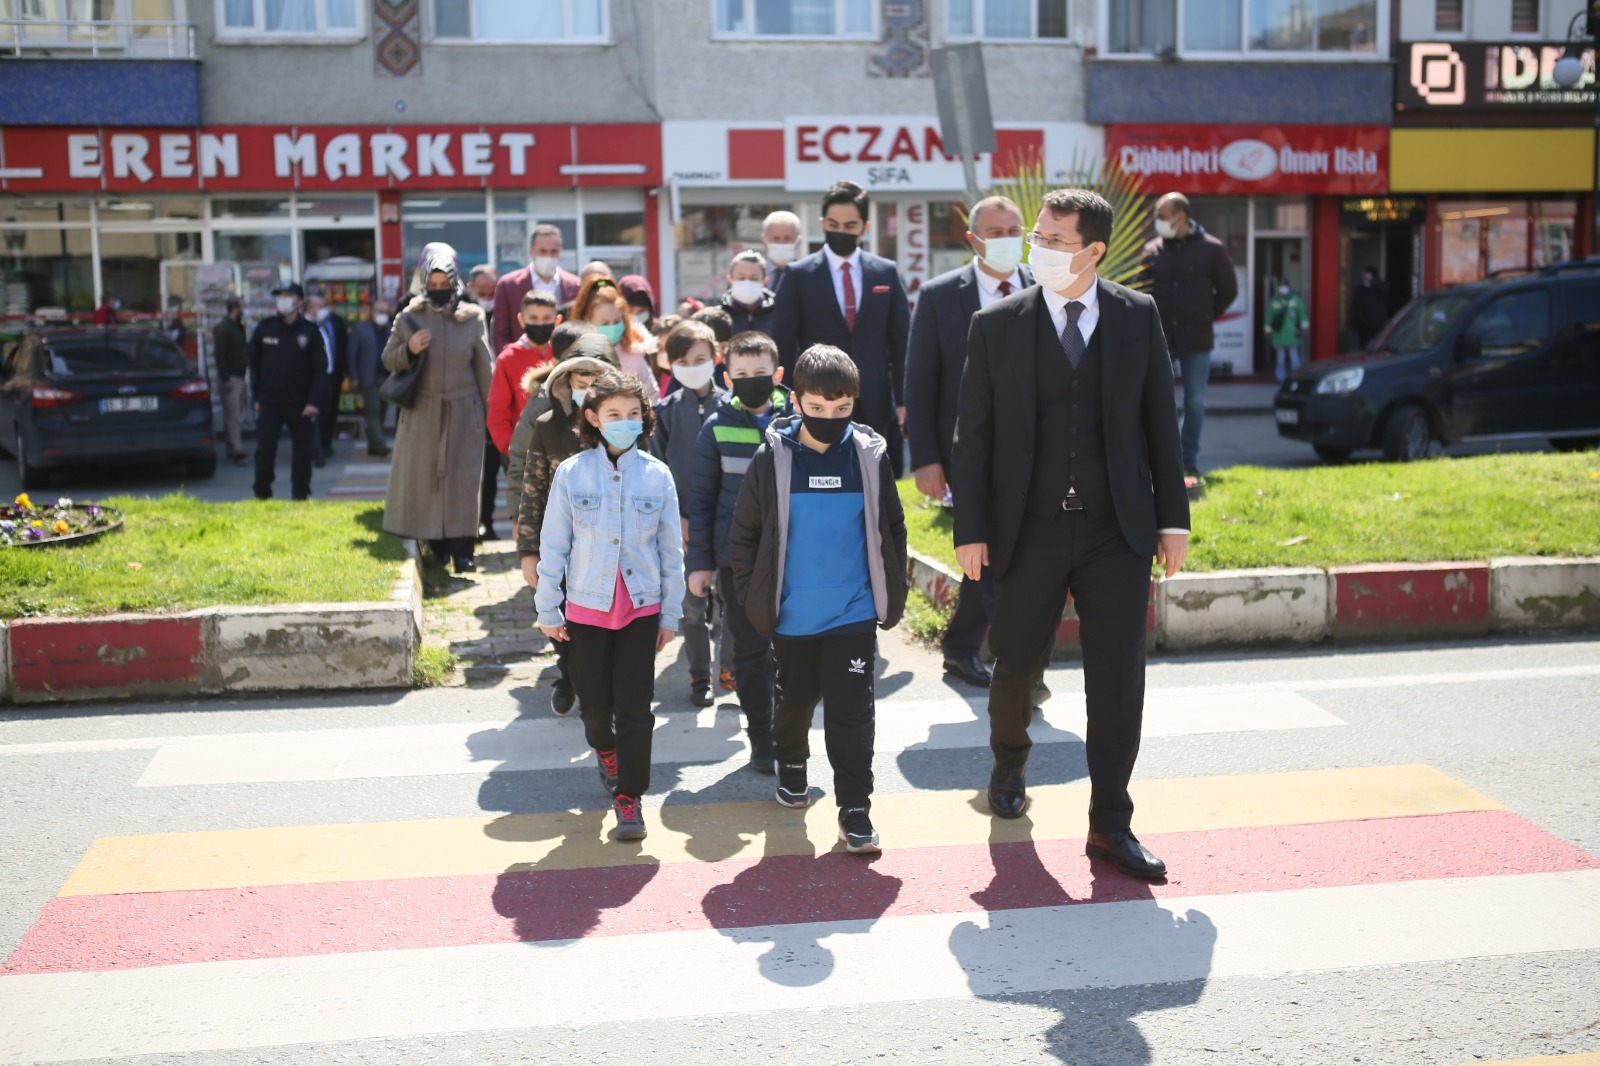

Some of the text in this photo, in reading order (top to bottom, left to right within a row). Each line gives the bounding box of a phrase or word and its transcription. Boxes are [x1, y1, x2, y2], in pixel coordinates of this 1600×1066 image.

[67, 132, 536, 183] EREN MARKET
[796, 126, 981, 163] ECZAN
[907, 205, 923, 310] ECZA
